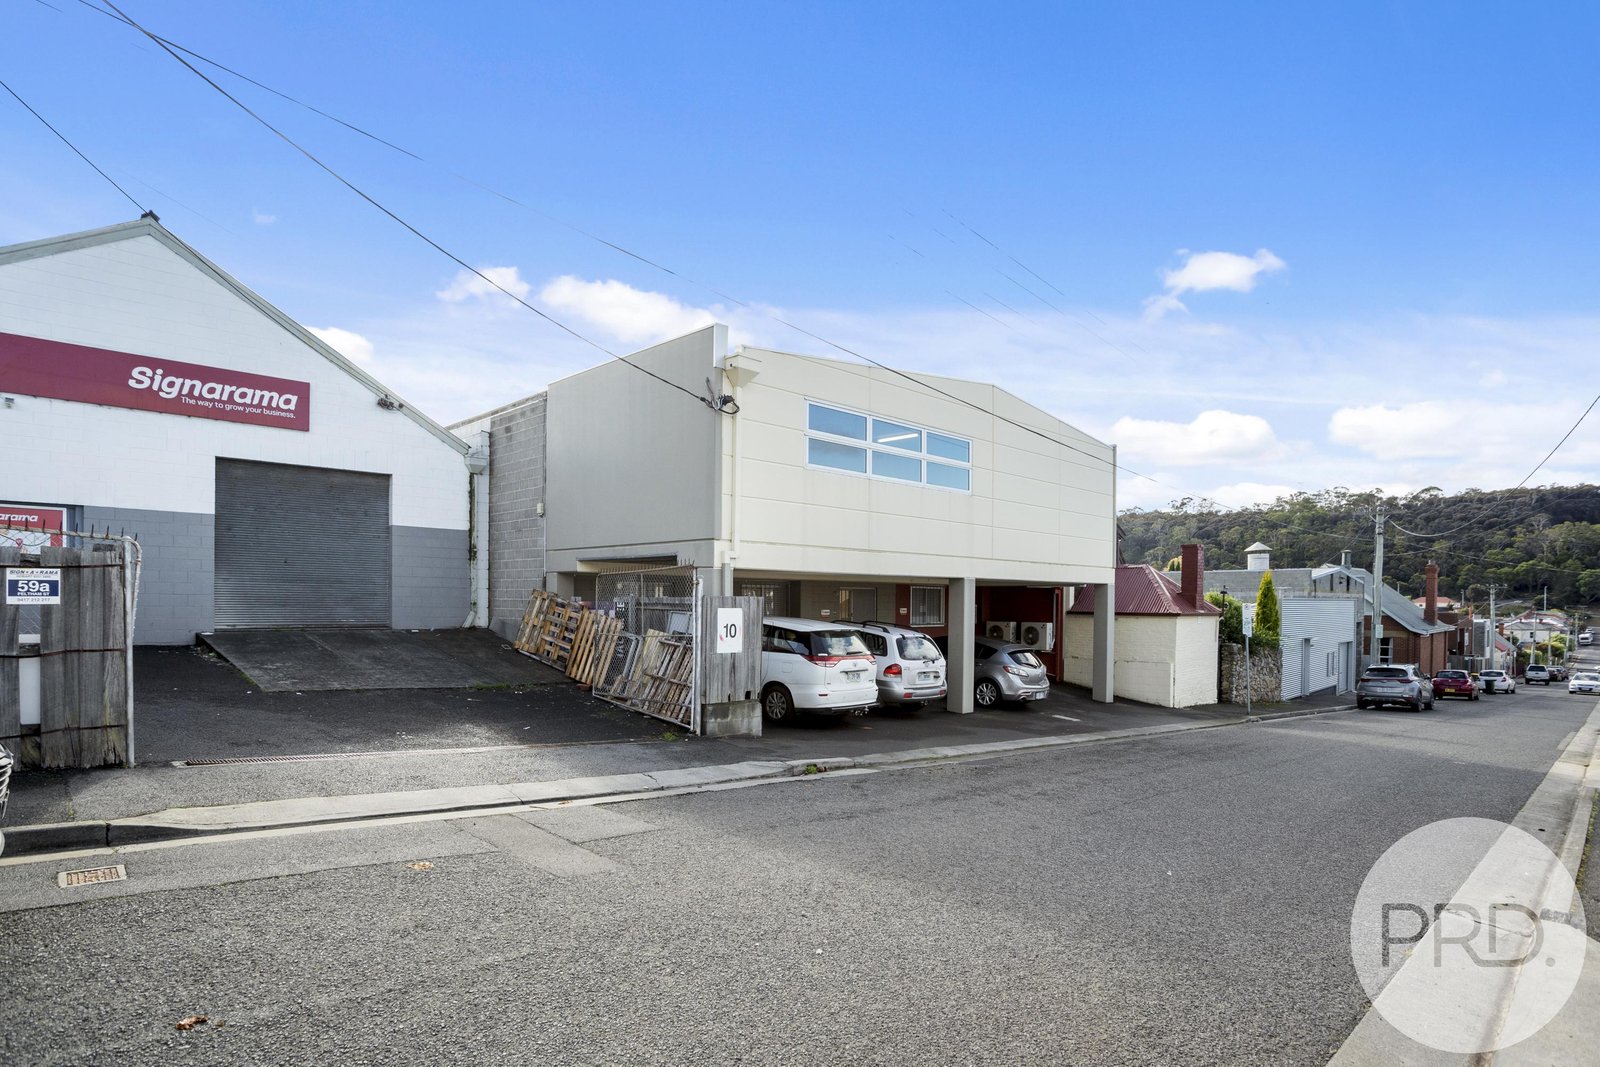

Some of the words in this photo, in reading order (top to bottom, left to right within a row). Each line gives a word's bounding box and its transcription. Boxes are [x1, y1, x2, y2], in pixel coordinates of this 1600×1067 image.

[128, 366, 298, 411] Signarama
[181, 396, 196, 405] The
[197, 399, 213, 408] way
[215, 401, 223, 409] to
[225, 403, 244, 411] grow
[245, 406, 262, 414] your
[263, 407, 296, 418] business.
[17, 580, 50, 592] 59a
[723, 623, 737, 638] 10
